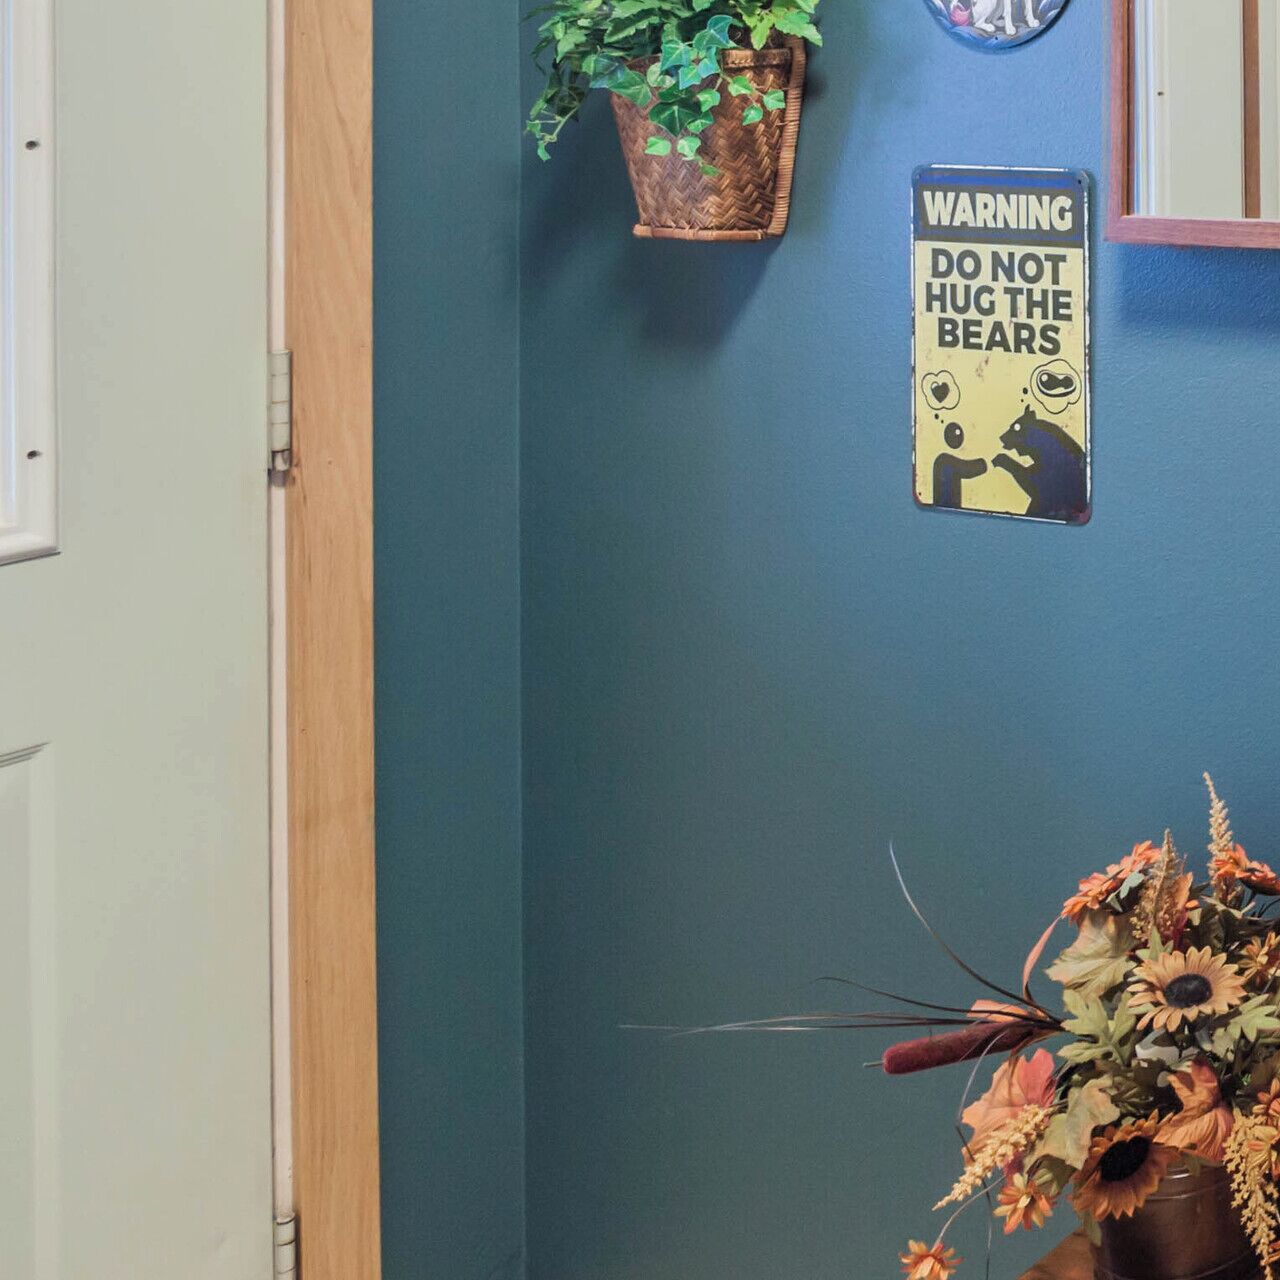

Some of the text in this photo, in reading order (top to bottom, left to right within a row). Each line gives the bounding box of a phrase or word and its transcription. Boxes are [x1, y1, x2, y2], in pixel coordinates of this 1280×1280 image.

[922, 190, 1073, 231] WARNING
[931, 247, 1067, 285] DO NOT
[925, 281, 1073, 321] HUG THE
[938, 316, 1061, 356] BEARS
